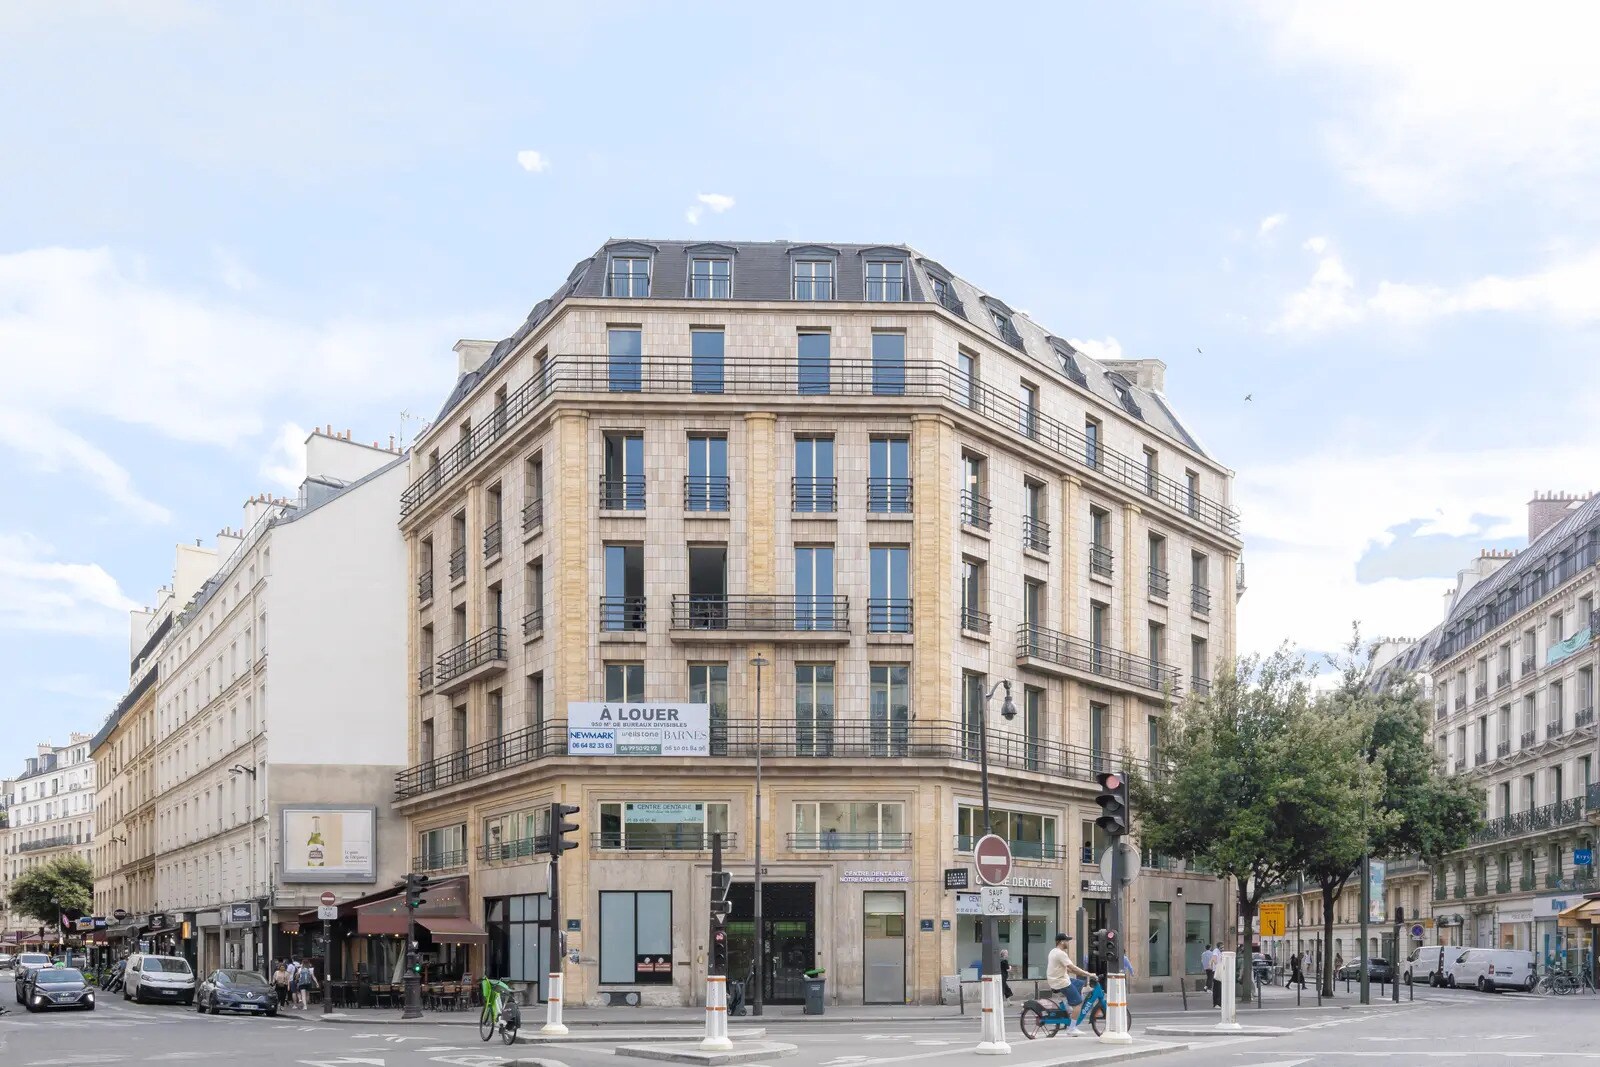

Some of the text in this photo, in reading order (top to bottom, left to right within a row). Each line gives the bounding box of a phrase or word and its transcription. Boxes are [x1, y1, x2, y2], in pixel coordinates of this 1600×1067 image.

[600, 705, 679, 721] À LOUER
[664, 730, 707, 740] BARNES
[1012, 877, 1052, 888] DENTAIRE
